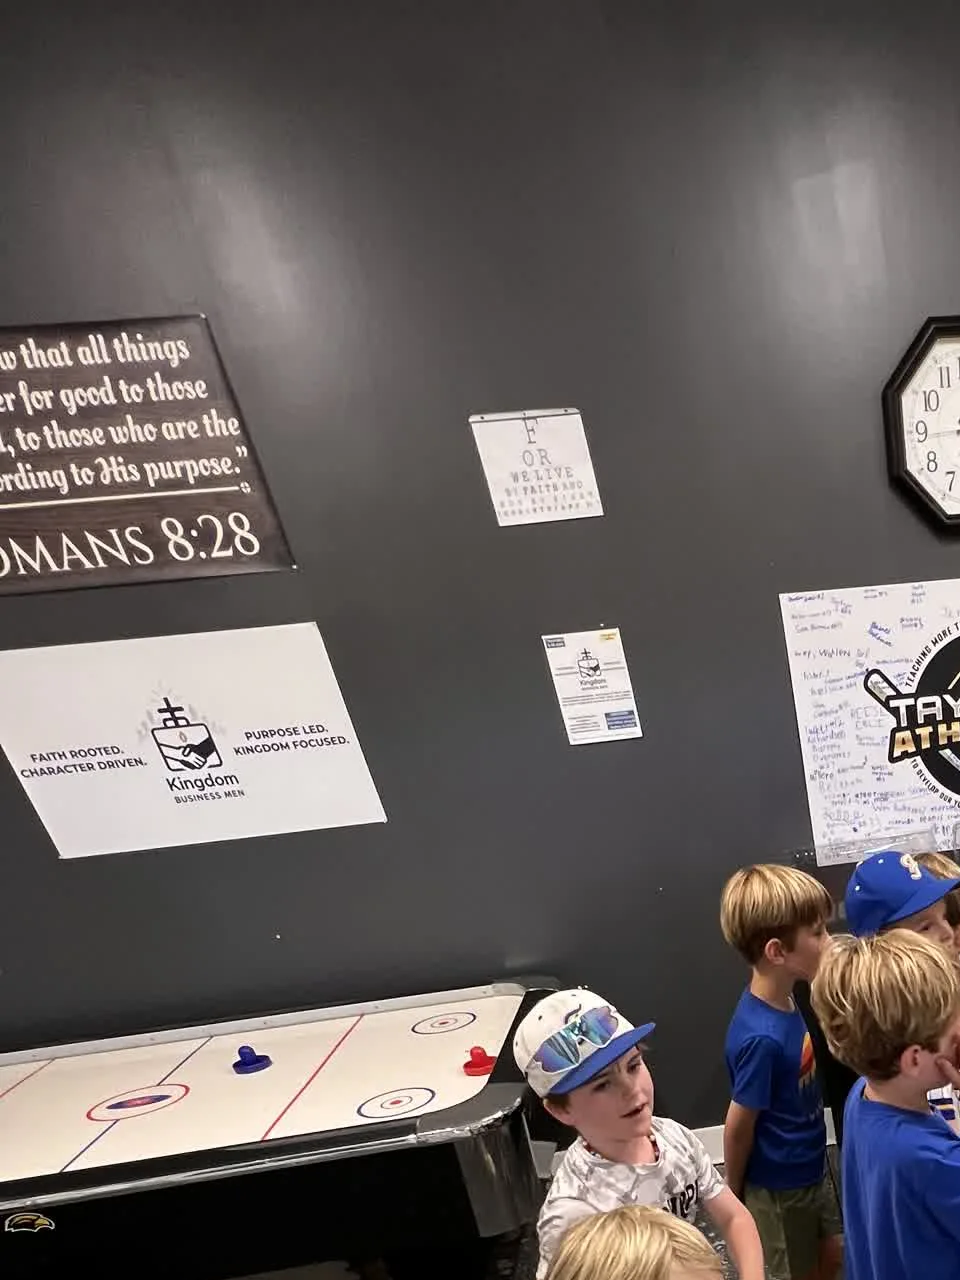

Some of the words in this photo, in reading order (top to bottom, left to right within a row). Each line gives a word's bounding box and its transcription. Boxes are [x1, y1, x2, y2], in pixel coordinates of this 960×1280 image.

[21, 338, 73, 369] that
[77, 334, 108, 365] all
[113, 332, 190, 366] things
[939, 366, 951, 388] 11
[18, 381, 54, 415] for
[60, 375, 117, 415] good
[119, 380, 144, 402] to
[146, 371, 209, 401] those
[923, 389, 940, 412] 10
[15, 427, 42, 451] to
[43, 420, 106, 449] those
[108, 414, 158, 444] who
[161, 420, 200, 440] are
[202, 408, 240, 436] the
[915, 420, 928, 443] 9
[522, 448, 551, 467] OR
[926, 451, 938, 473] 8
[70, 463, 95, 486] to
[91, 457, 141, 484] His
[534, 466, 573, 482] LIVE
[945, 471, 956, 492] 7
[160, 512, 260, 562] 8:28
[905, 645, 931, 687] TEACHING
[931, 627, 952, 647] MORE
[244, 726, 301, 741] PURPOSE
[302, 723, 329, 737] LED.
[30, 750, 67, 763] FAITH
[71, 745, 124, 760] ROOTED.
[233, 740, 290, 756] KINGDOM
[292, 735, 350, 752] FOCUSED.
[20, 761, 95, 778] CHARACTER
[99, 756, 148, 771] DRIVEN.
[166, 773, 240, 791] Kingdom
[174, 790, 222, 804] BUSINESS
[224, 788, 246, 799] MEN
[939, 791, 952, 804] OUR
